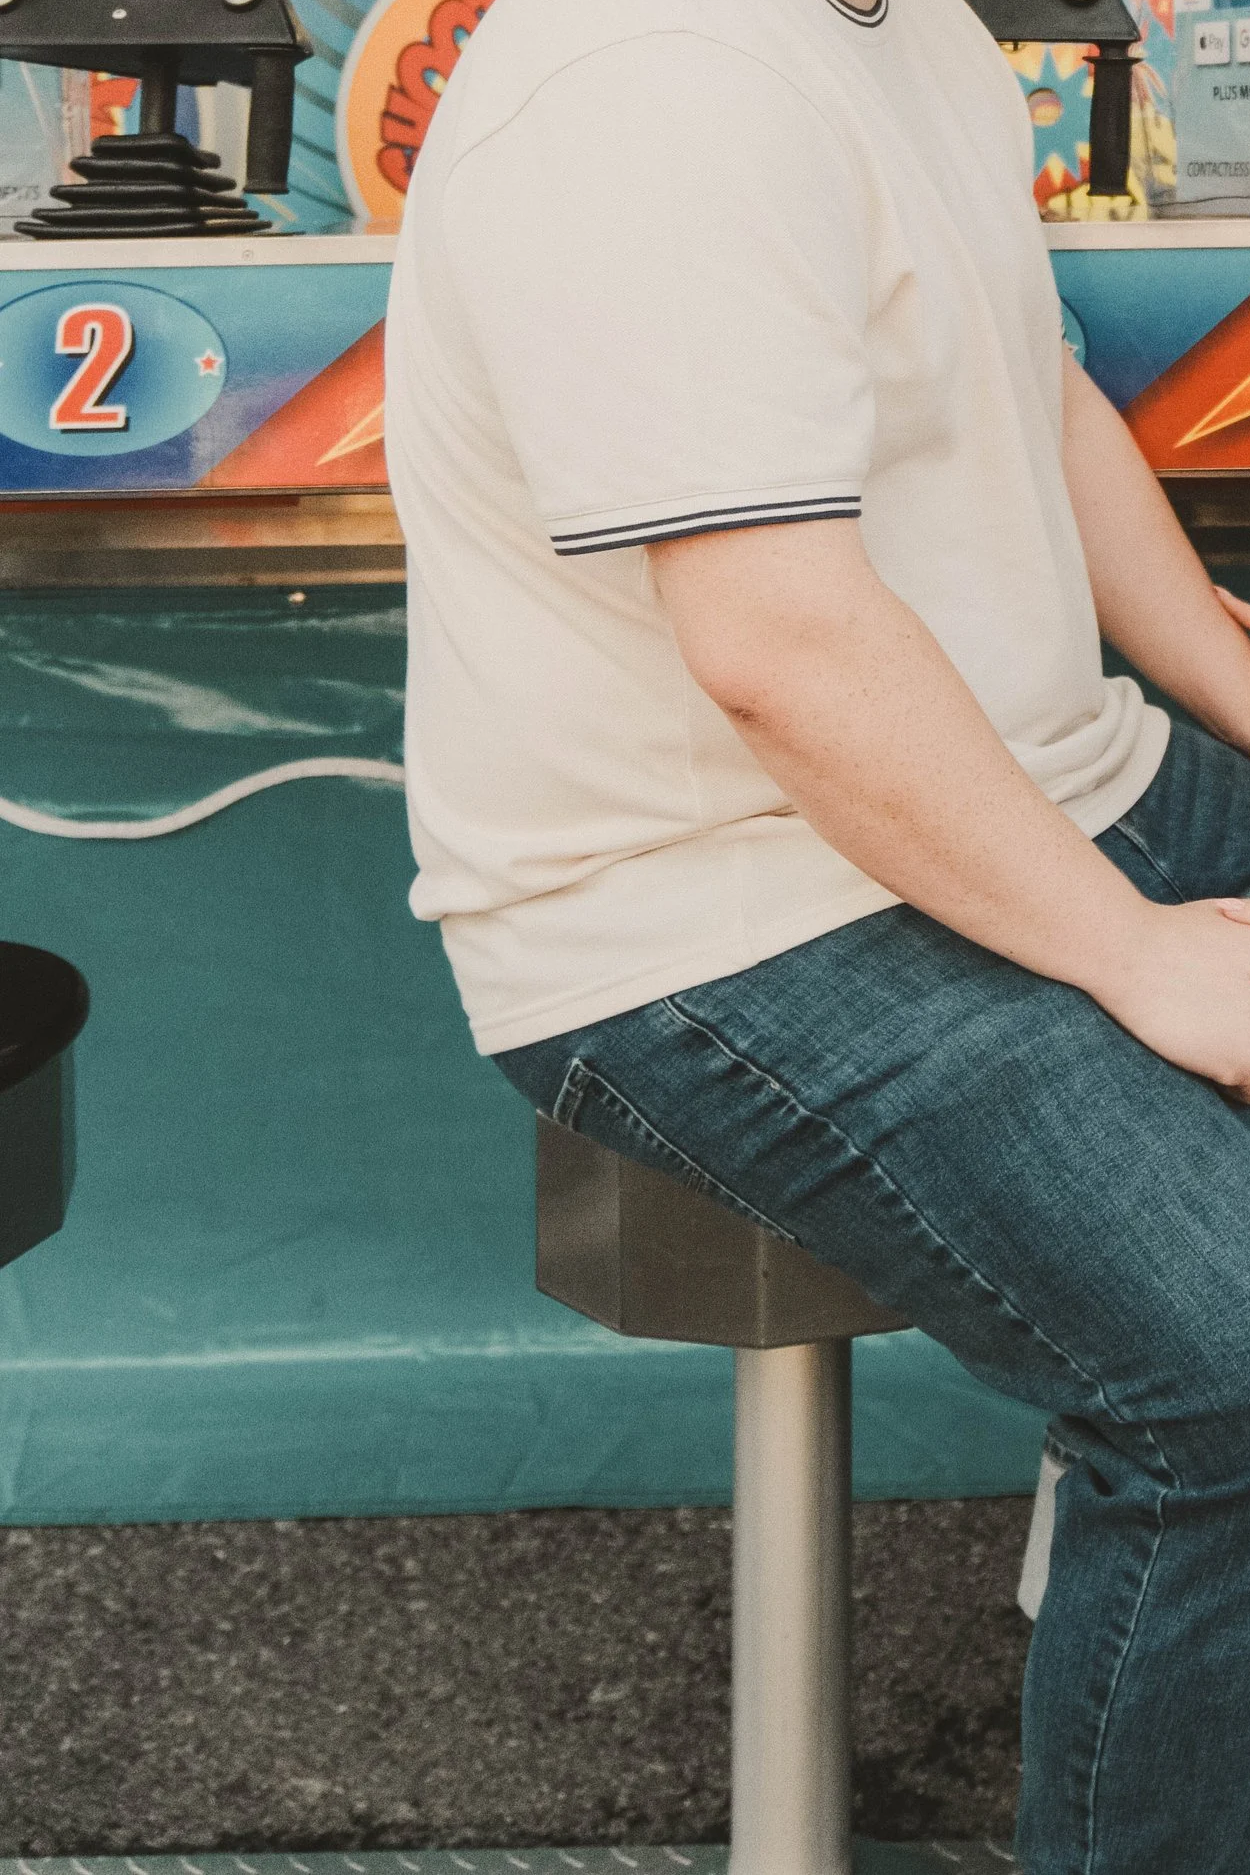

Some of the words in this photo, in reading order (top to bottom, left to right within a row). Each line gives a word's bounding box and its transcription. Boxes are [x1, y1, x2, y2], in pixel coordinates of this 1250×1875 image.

[1212, 85, 1237, 101] PLUS
[1186, 161, 1249, 178] CONTACTLESS
[49, 301, 134, 431] 2
